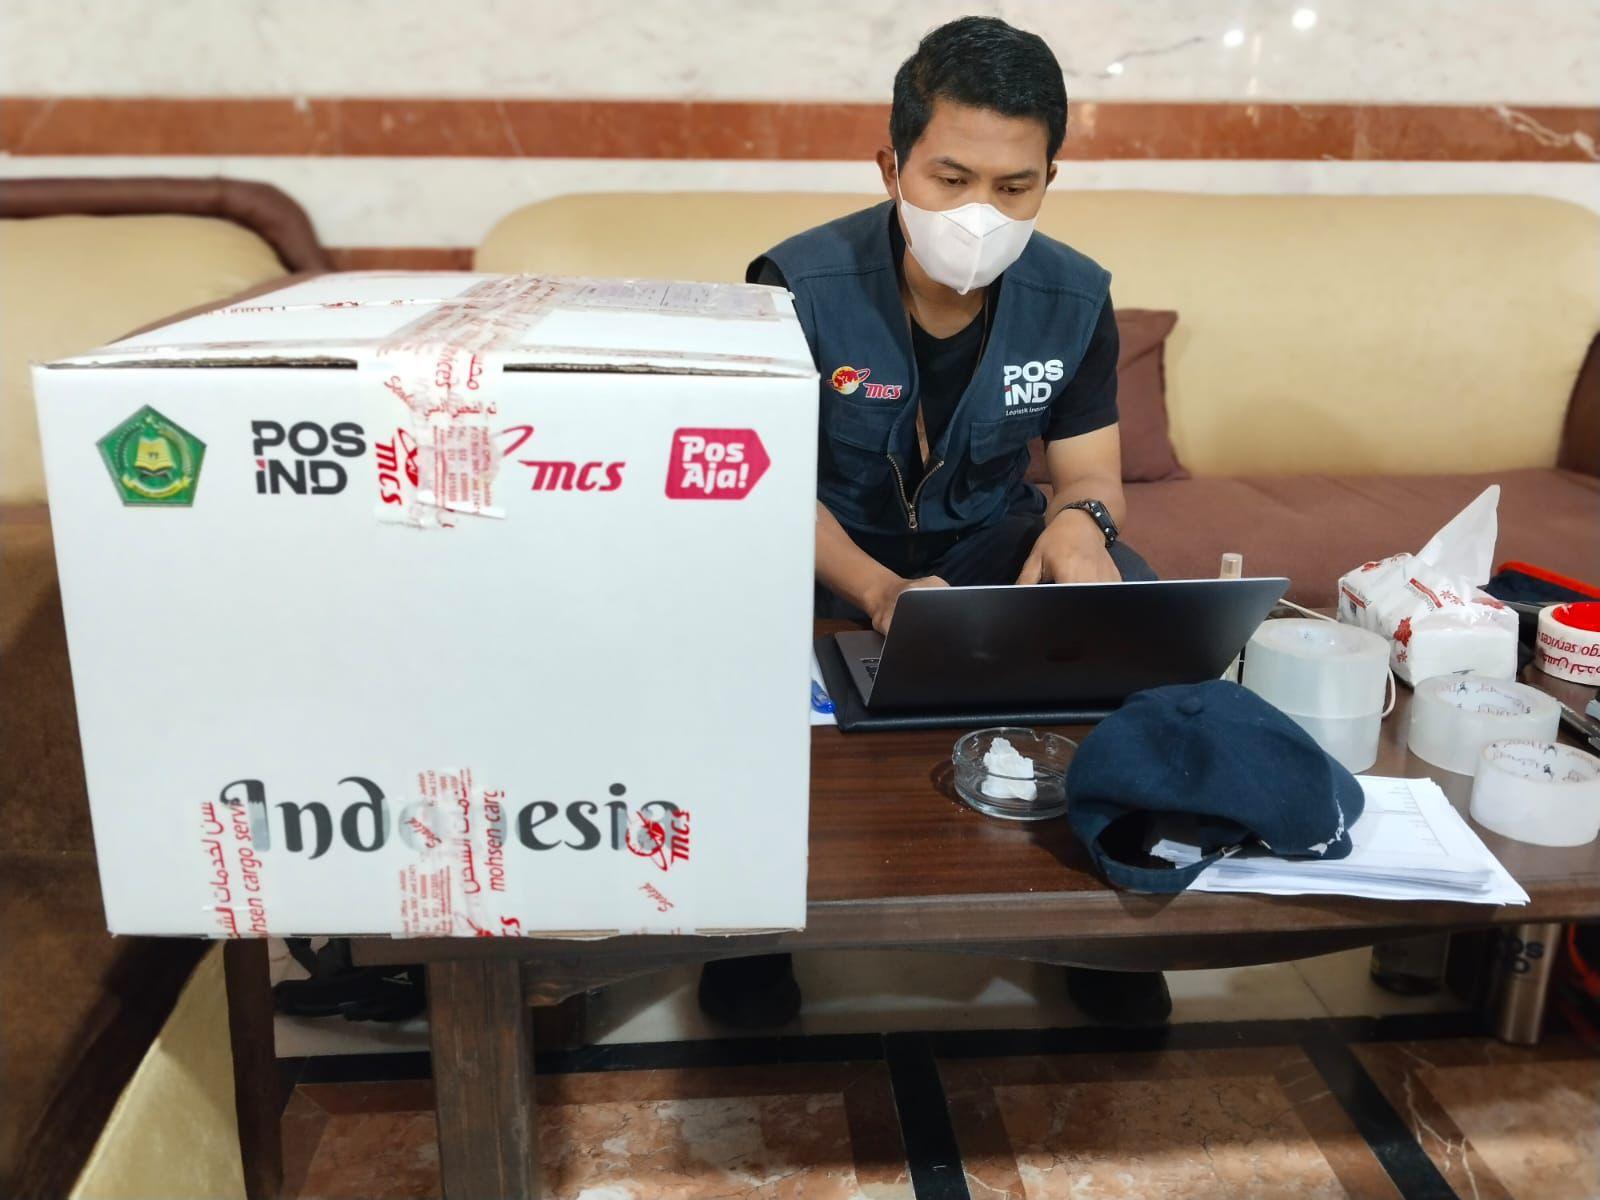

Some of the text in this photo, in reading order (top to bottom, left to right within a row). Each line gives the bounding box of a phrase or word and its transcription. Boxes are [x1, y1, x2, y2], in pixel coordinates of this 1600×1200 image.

[1003, 359, 1064, 386] POS
[251, 420, 367, 457] POS
[679, 435, 745, 463] Pos
[681, 465, 749, 494] Aja!
[237, 847, 263, 893] cargo
[483, 828, 505, 892] mohsen
